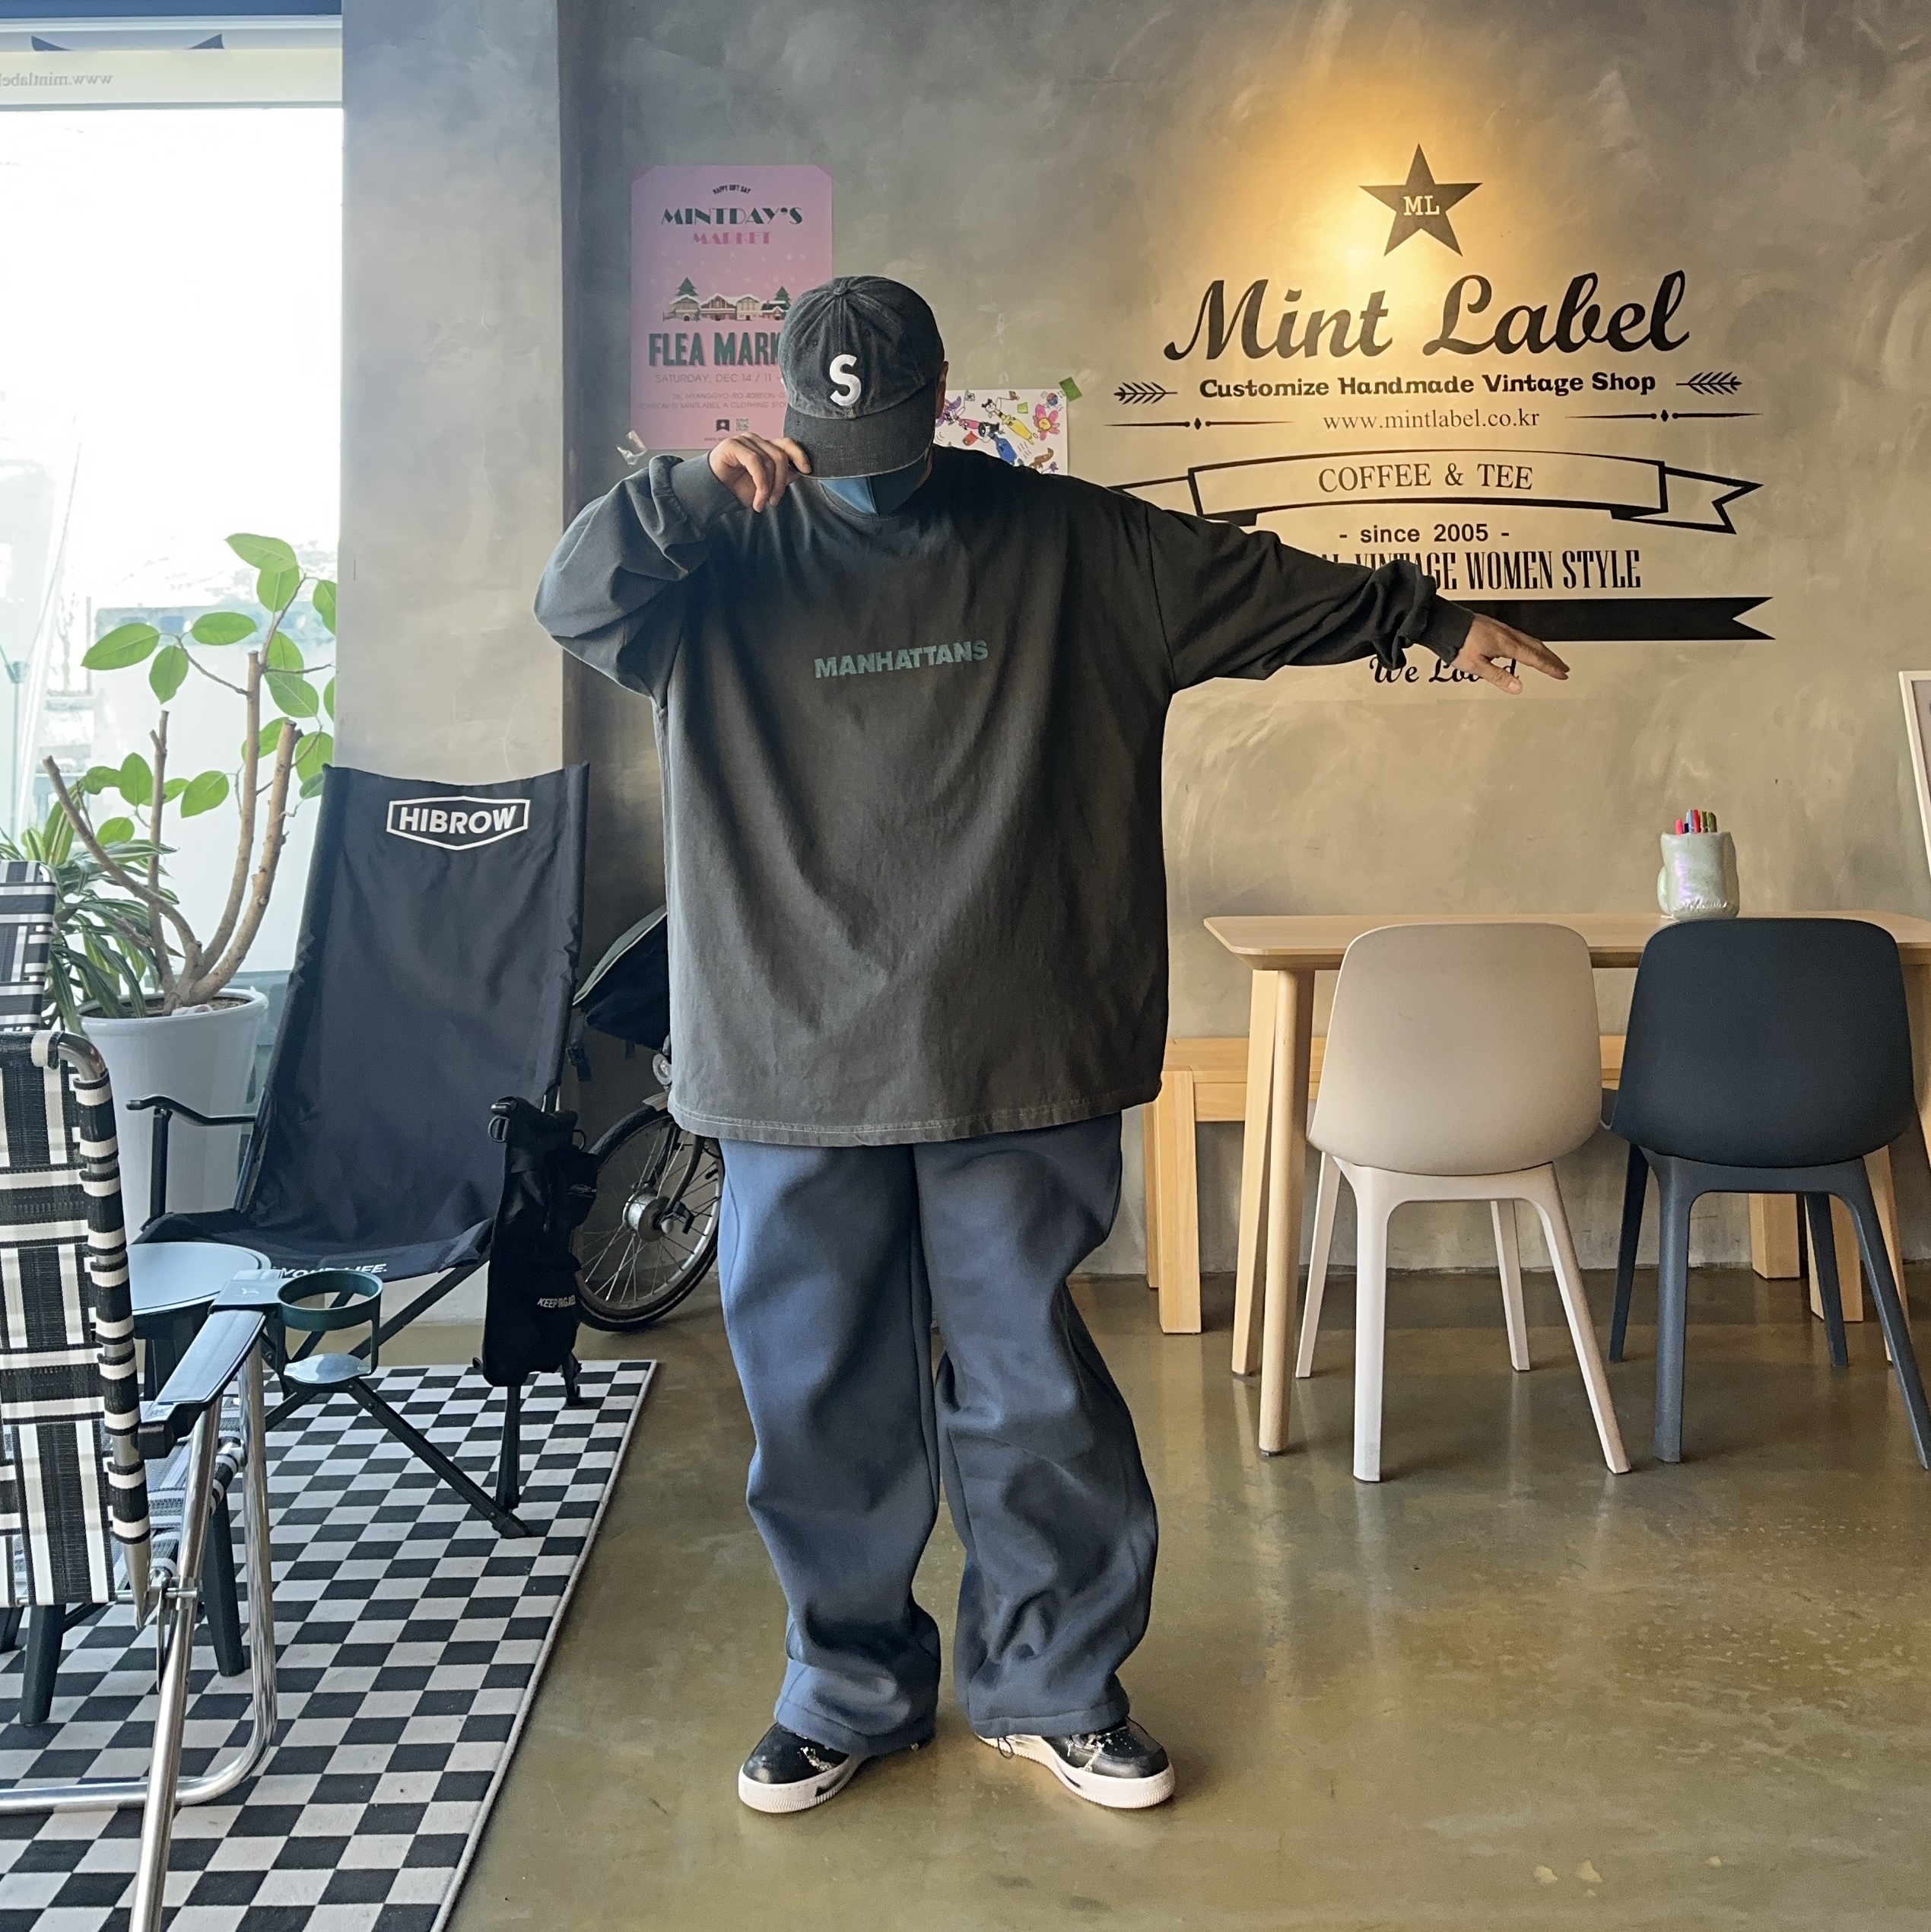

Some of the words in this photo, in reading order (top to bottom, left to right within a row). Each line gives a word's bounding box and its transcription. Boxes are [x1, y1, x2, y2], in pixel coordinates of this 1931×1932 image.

[661, 208, 803, 225] MINTDAY'S
[1403, 195, 1440, 216] ML
[691, 231, 772, 245] MARKET
[1164, 279, 1393, 361] Mint
[1422, 269, 1690, 356] Label
[649, 332, 705, 367] FLEA
[656, 373, 711, 383] SATURDAY,
[829, 354, 862, 406] S
[1199, 378, 1329, 397] Customize
[1337, 376, 1474, 395] Handmade
[1482, 373, 1583, 396] Vintage
[1592, 371, 1656, 396] Shop
[1323, 408, 1540, 430] www.mintlabel.co.kr
[1318, 463, 1432, 493] COFFEE
[1445, 462, 1464, 486] &
[1477, 463, 1533, 490] TEE
[1360, 525, 1421, 543] since
[1434, 523, 1489, 542] 2005
[1465, 551, 1553, 589] WOMEN
[1562, 550, 1641, 588] STYLE
[814, 640, 988, 678] MANHATTANS
[1428, 658, 1520, 683] Lod
[399, 806, 517, 834] HIBROW
[537, 1298, 558, 1308] KEEP
